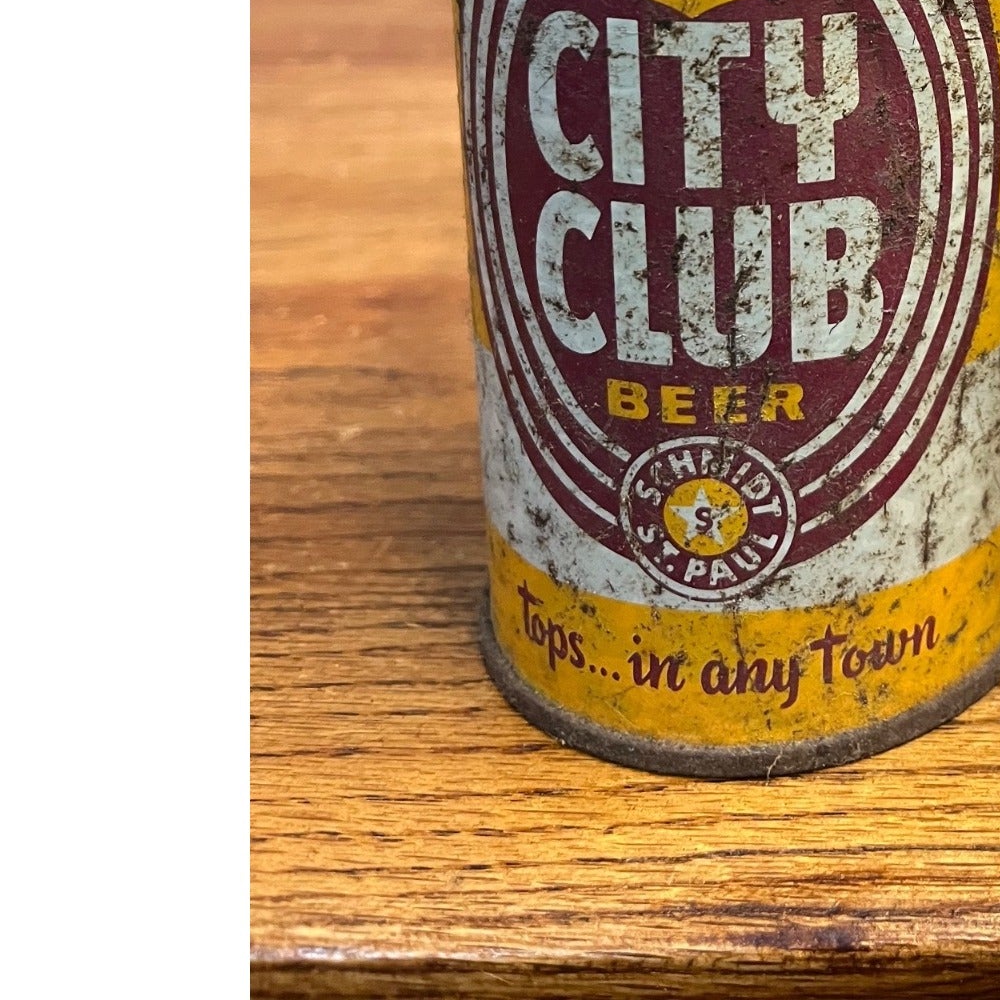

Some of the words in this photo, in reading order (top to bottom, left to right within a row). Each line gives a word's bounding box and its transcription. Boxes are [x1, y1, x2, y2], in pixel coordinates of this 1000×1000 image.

[527, 10, 861, 189] CITY
[535, 189, 883, 368] CLUB
[606, 378, 805, 425] BEER
[636, 523, 681, 573] ST.
[683, 533, 779, 586] PAUL
[694, 506, 714, 533] S
[627, 633, 686, 692] in
[700, 656, 800, 710] any
